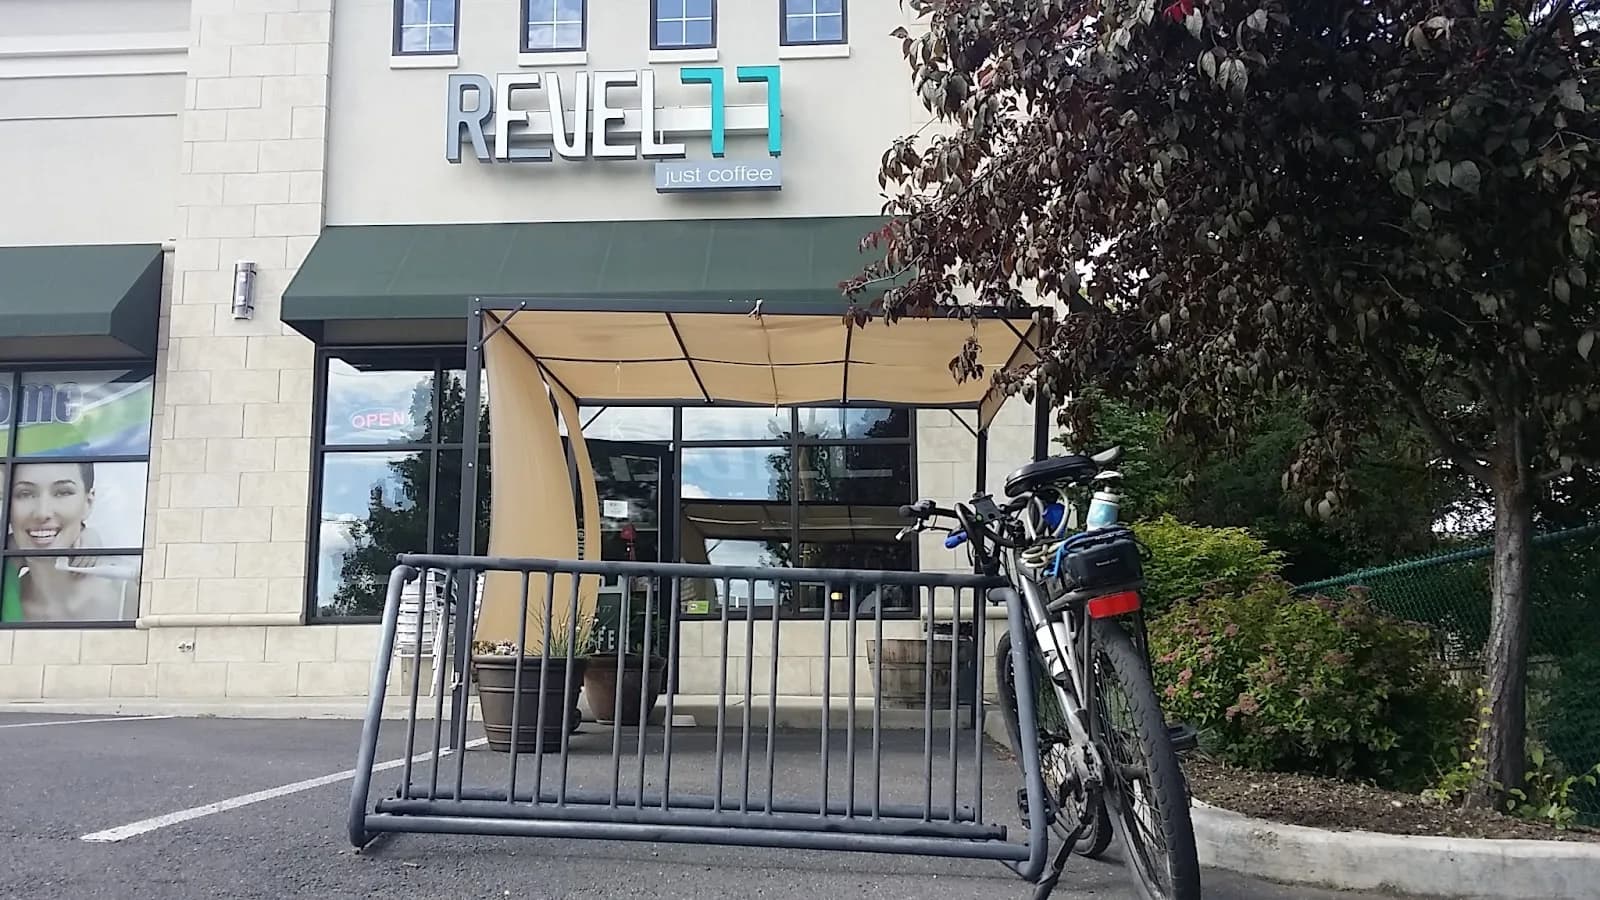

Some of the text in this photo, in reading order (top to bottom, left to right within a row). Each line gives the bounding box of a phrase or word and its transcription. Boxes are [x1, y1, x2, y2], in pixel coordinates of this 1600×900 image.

[446, 69, 686, 162] REVEL
[664, 165, 773, 185] just coffee
[351, 411, 405, 429] OPEN
